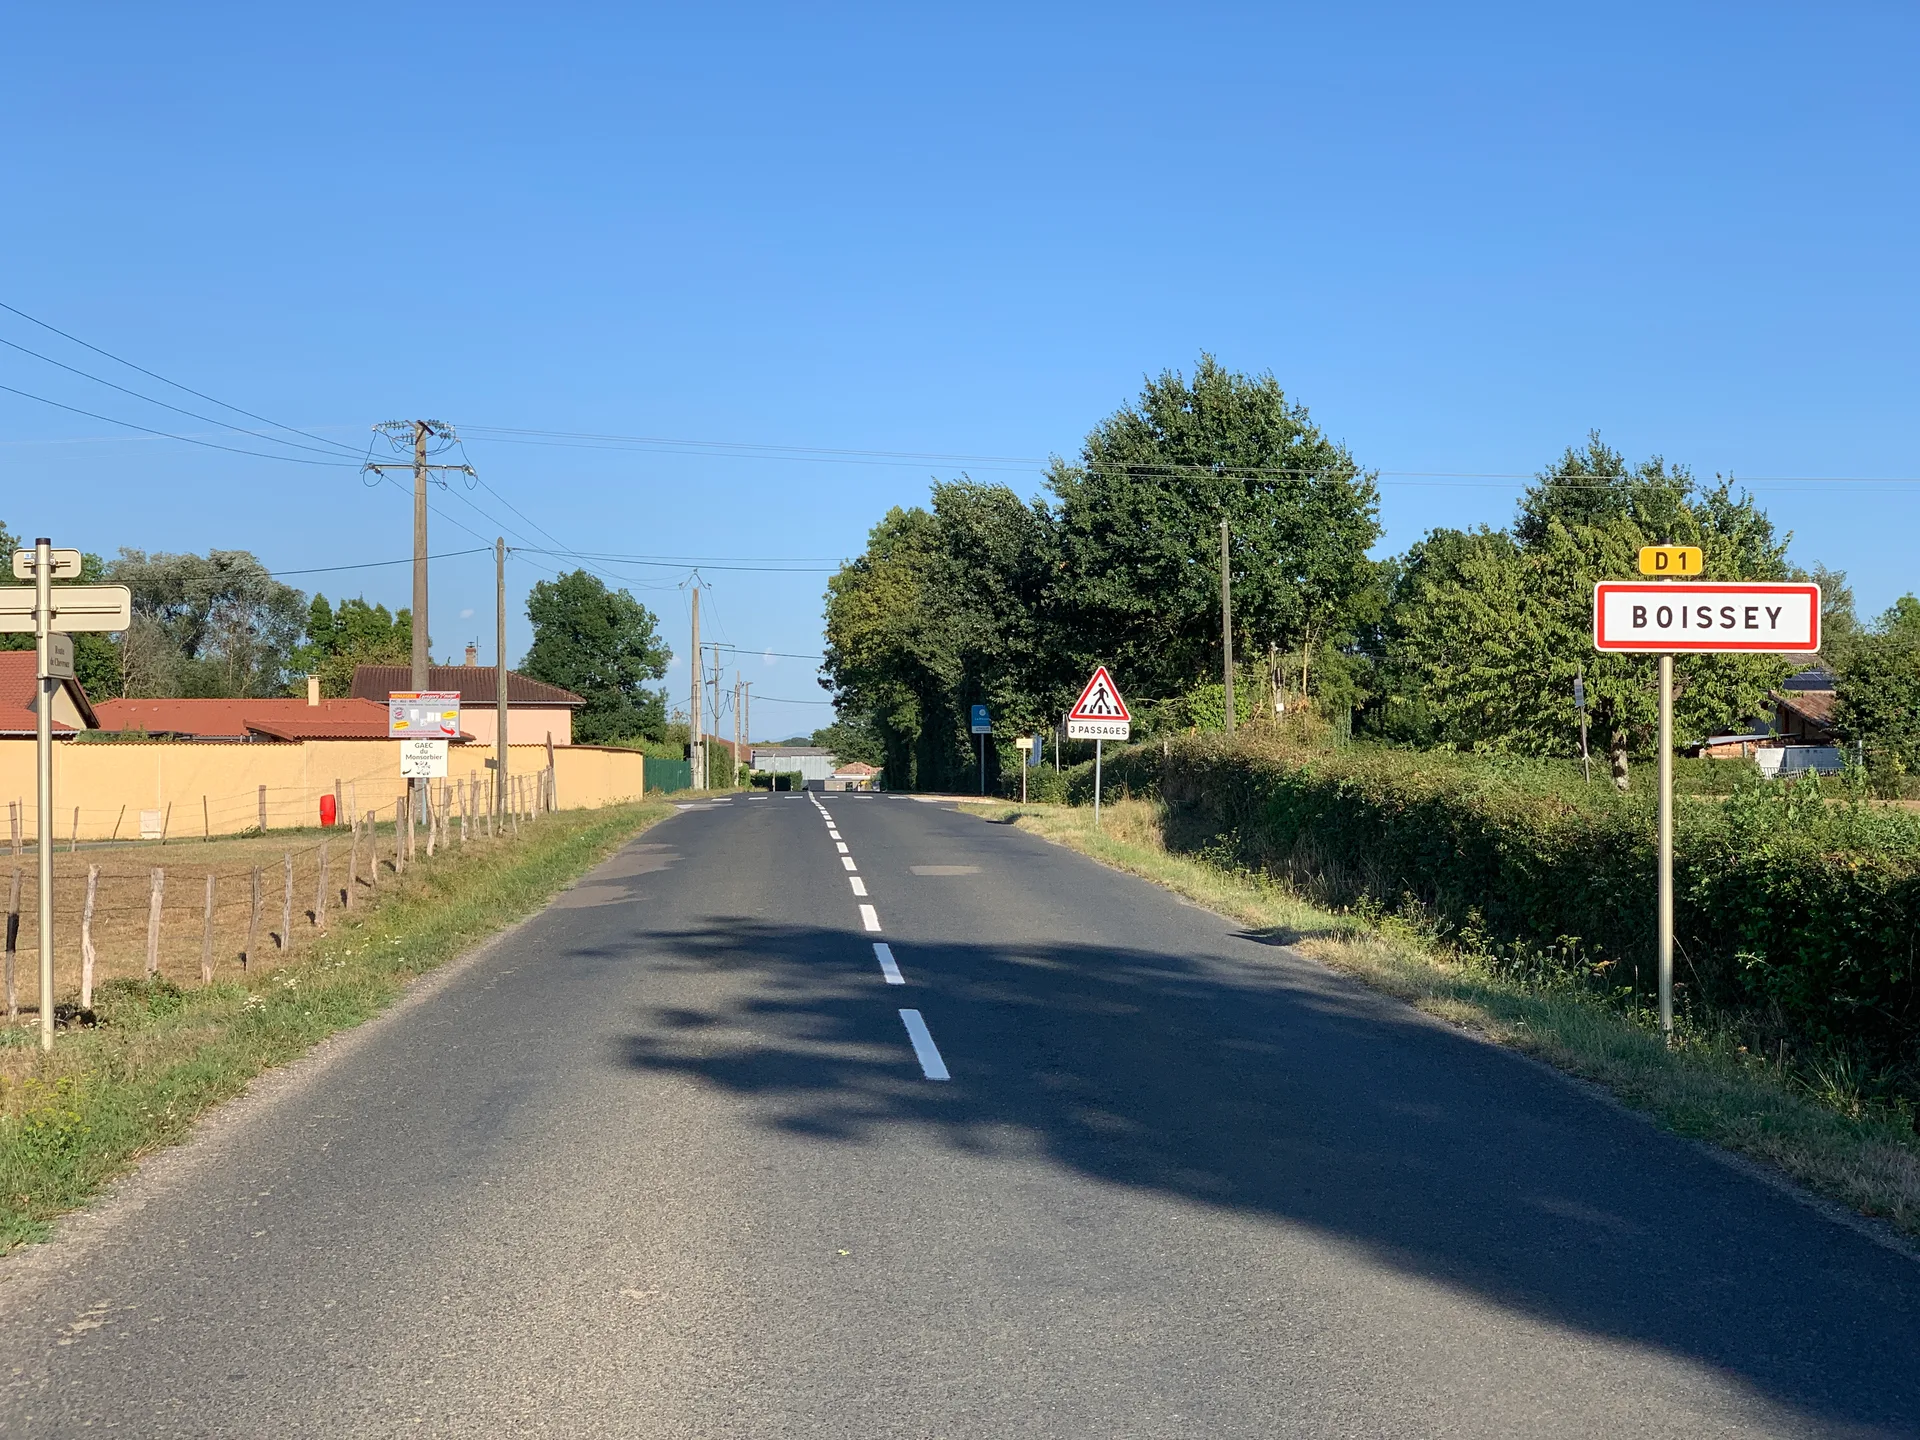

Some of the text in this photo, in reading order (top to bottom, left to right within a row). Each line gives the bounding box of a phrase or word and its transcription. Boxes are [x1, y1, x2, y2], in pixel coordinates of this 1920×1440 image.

[1655, 552, 1687, 570] D 1
[1632, 605, 1782, 630] BOISSEY
[1070, 725, 1127, 735] 3 PASSAGES
